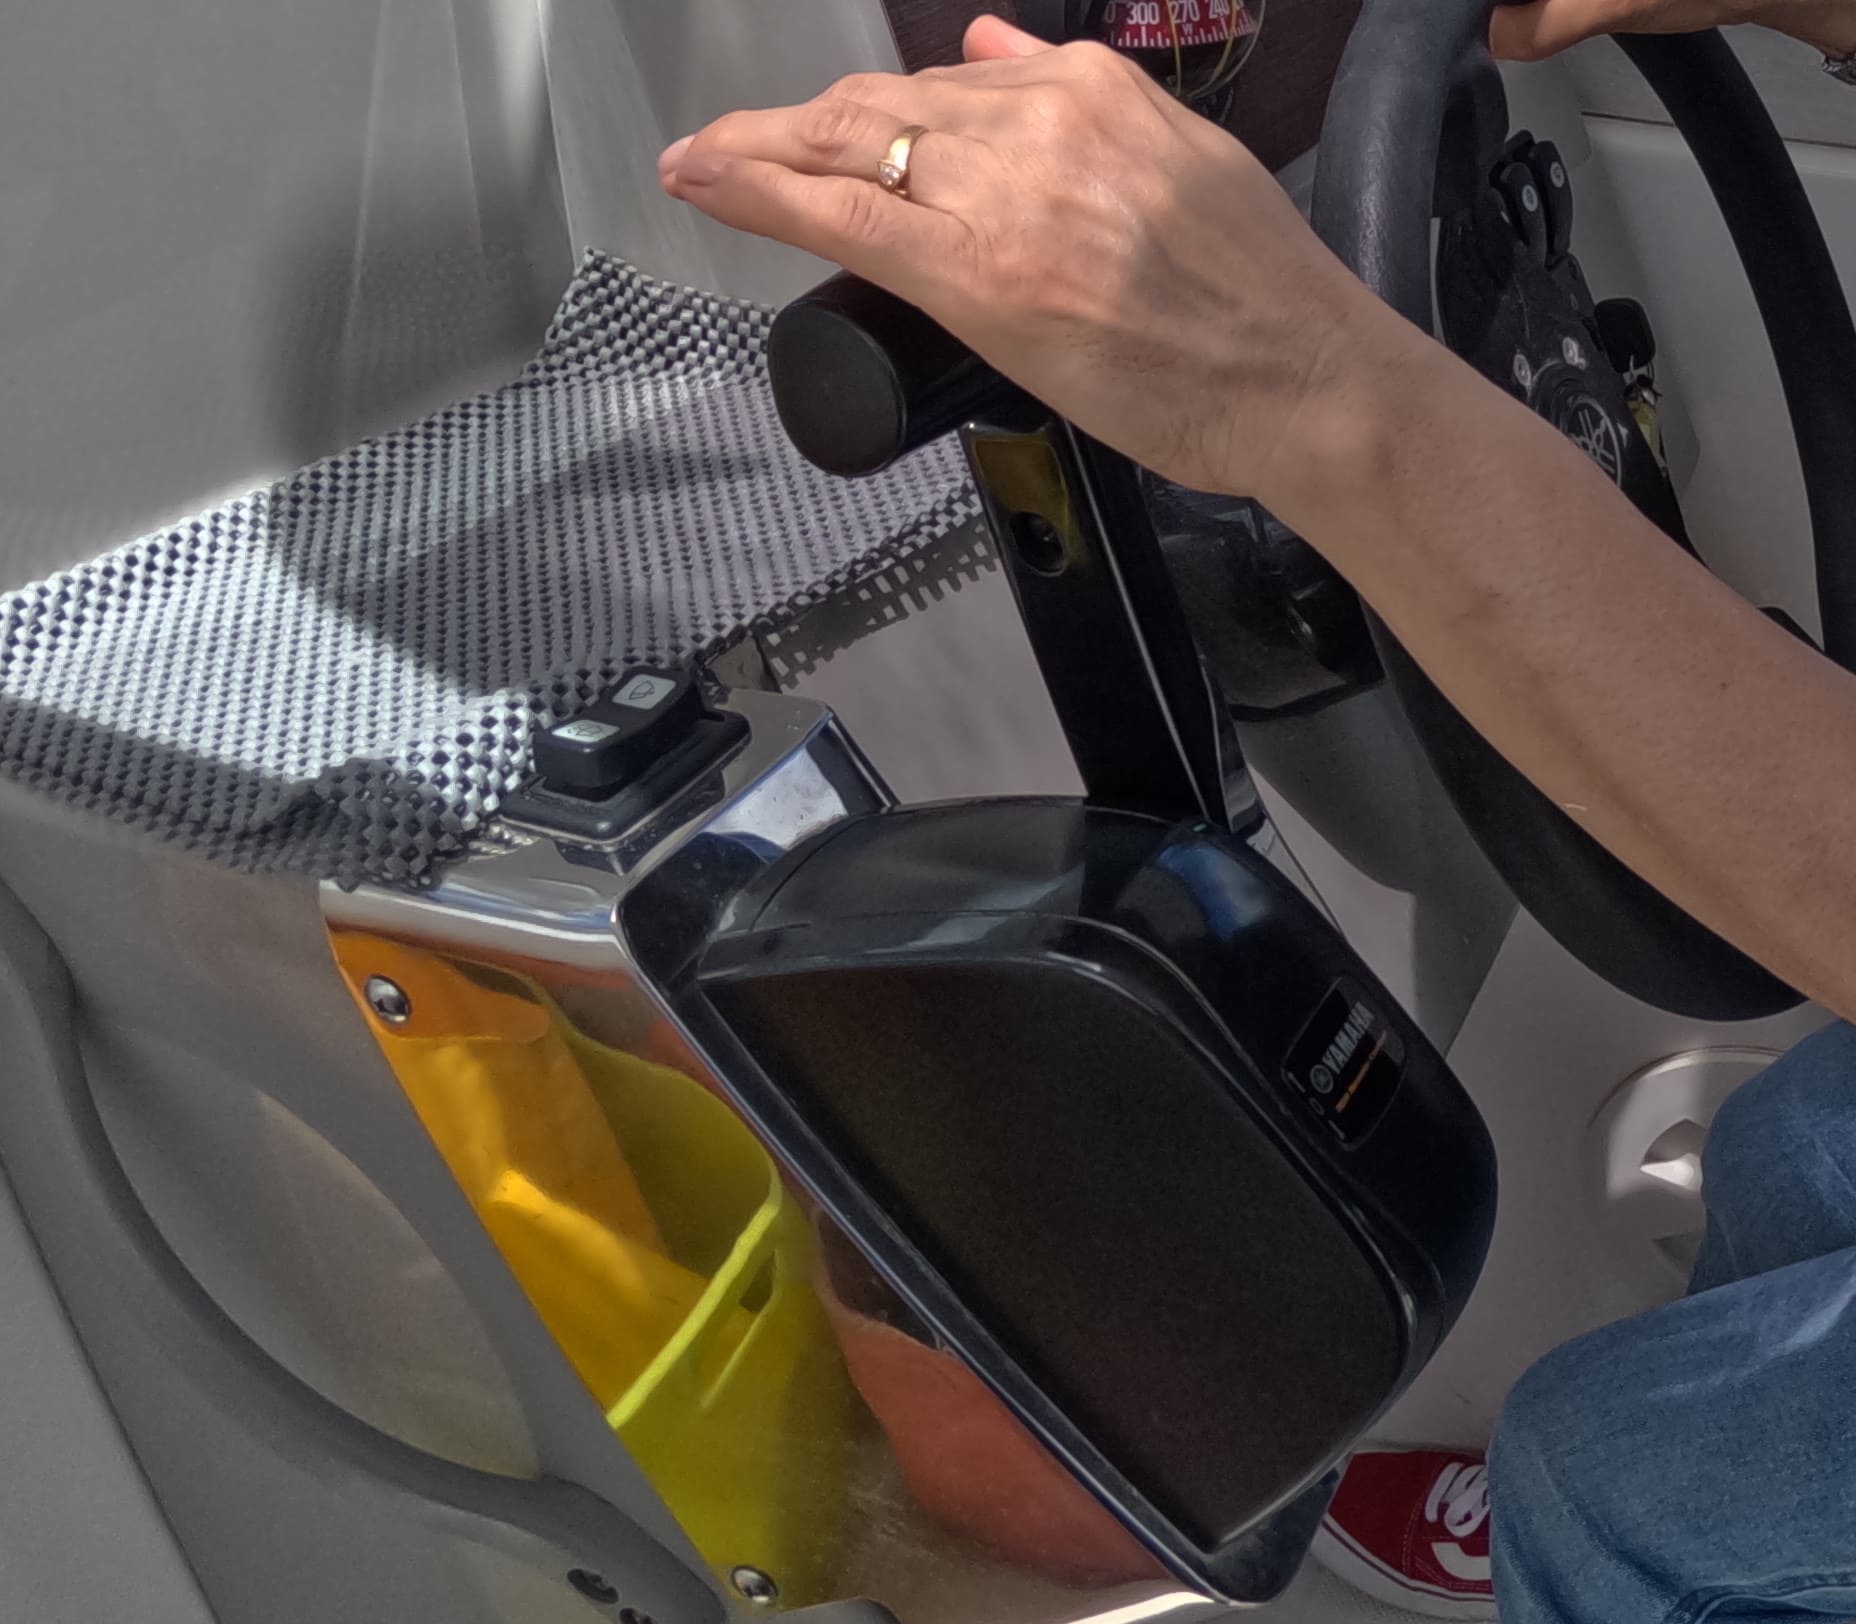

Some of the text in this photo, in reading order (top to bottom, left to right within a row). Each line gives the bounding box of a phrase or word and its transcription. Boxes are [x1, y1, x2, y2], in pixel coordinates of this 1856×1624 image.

[1126, 1, 1160, 25] 300
[1181, 23, 1194, 36] W
[1321, 1000, 1377, 1076] YAMAHA
